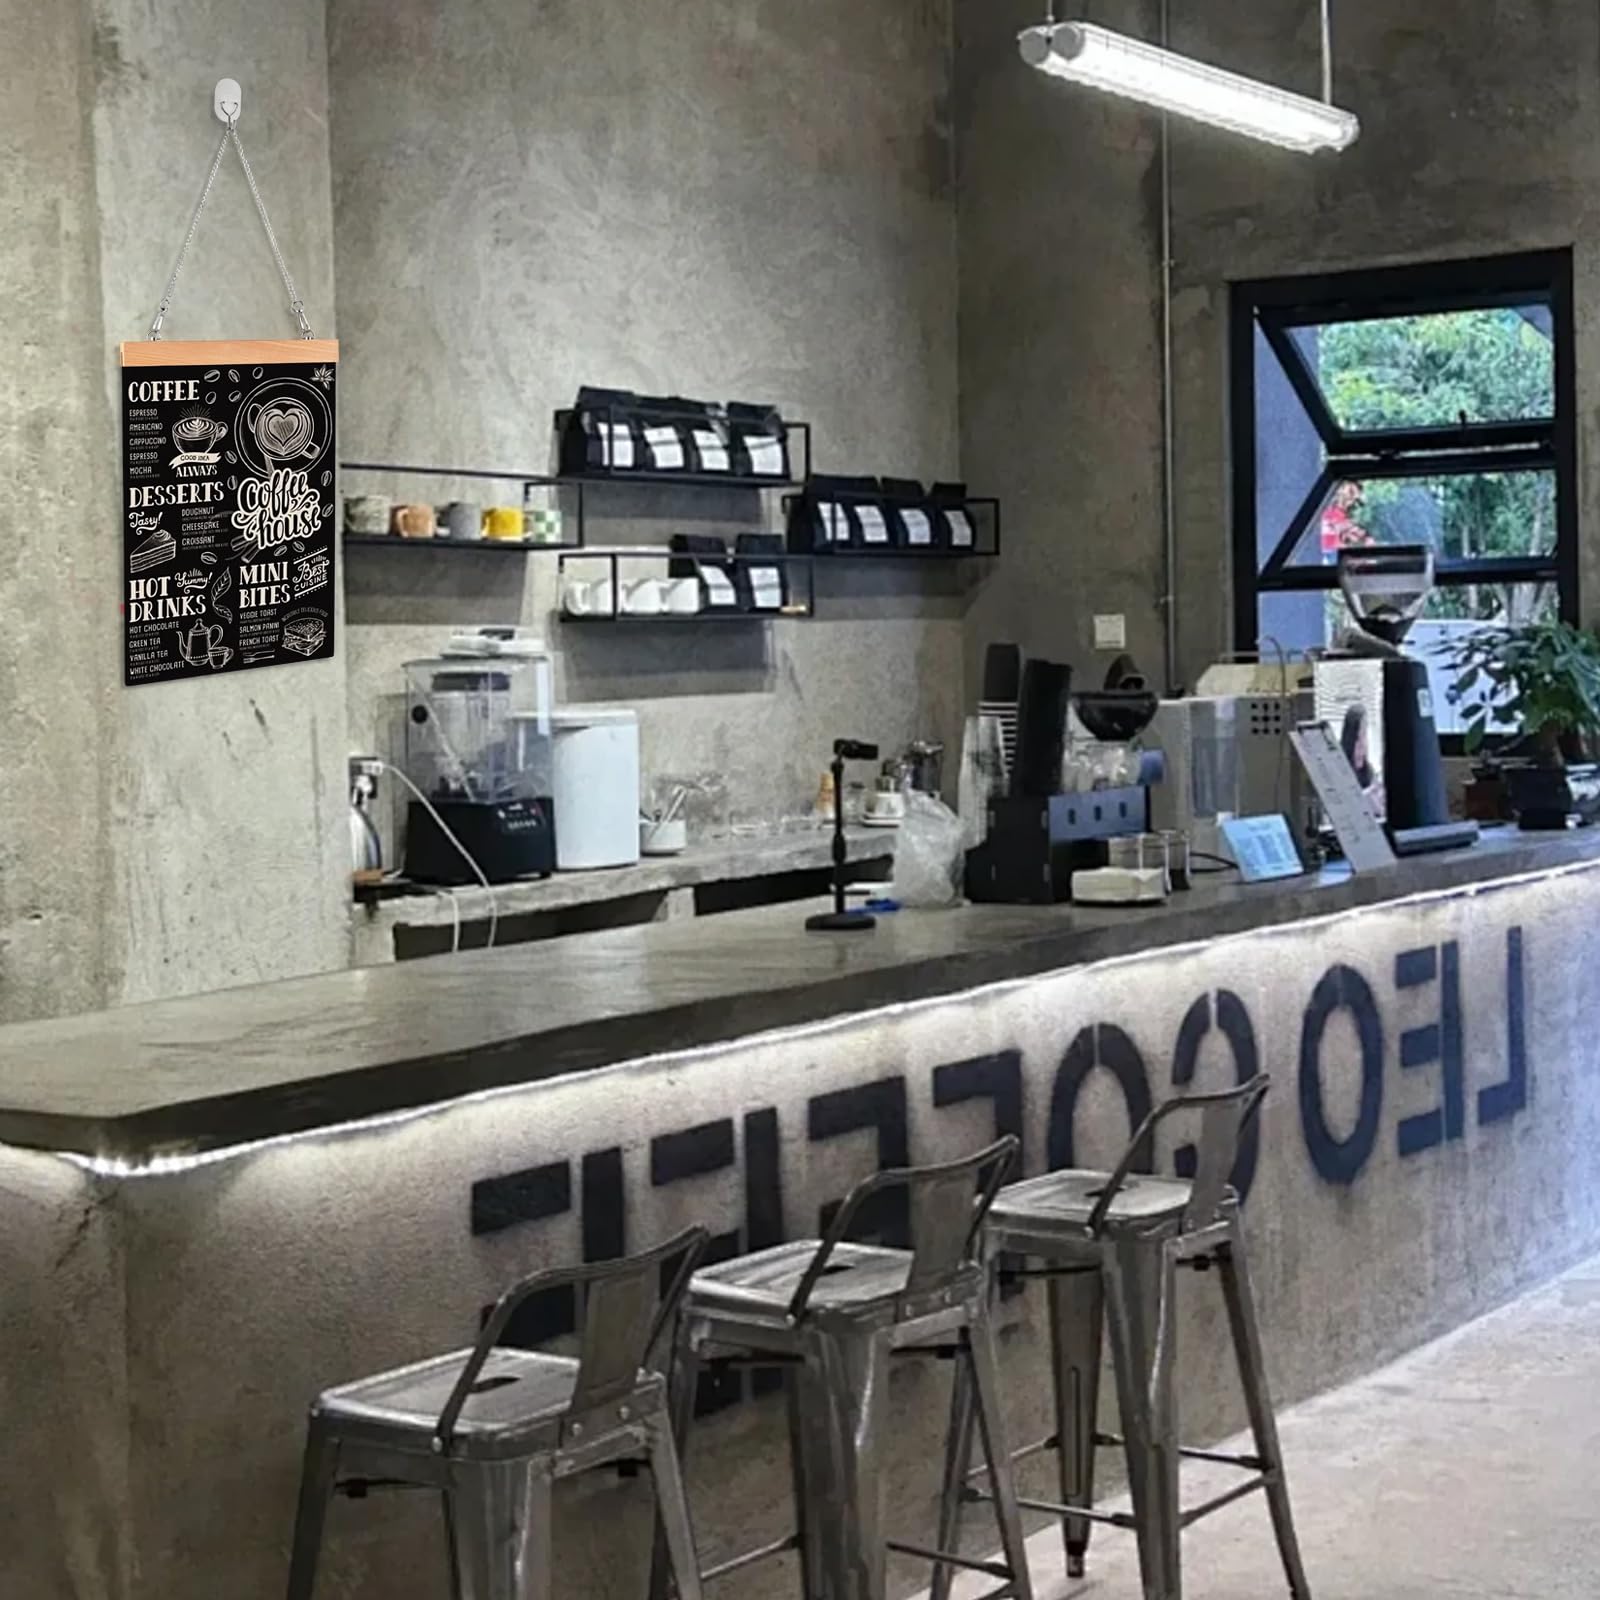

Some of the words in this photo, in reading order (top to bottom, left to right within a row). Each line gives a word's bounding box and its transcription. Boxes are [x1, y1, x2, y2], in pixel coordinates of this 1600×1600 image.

[128, 380, 200, 403] COFFEE
[129, 409, 158, 418] ESPRESSO
[129, 437, 167, 446] CAPPUCCINO
[129, 452, 158, 461] ESPRESSO
[129, 466, 152, 475] MOCHA
[176, 464, 218, 478] ALWAYS
[128, 481, 225, 508] DESSERTS
[237, 468, 316, 518] Coffee
[181, 507, 214, 517] DOUGHNUT
[128, 511, 163, 536] Tasty!
[181, 521, 220, 532] CHEESECAKE
[181, 536, 215, 546] CROISSANT
[239, 561, 289, 586] MINI
[292, 560, 330, 583] Best
[129, 576, 171, 601] HOT
[174, 572, 213, 594] Yummy!
[294, 572, 328, 592] CUISINE
[239, 583, 291, 609] BITES
[129, 594, 207, 623] DRINKS
[260, 608, 277, 617] TOAST
[129, 626, 142, 635] HOT
[143, 621, 180, 633] CHOCOLATE
[149, 637, 161, 646] TEA
[261, 634, 279, 644] TOAST
[156, 649, 168, 658] TEA
[149, 660, 185, 673] CHOCOLATE
